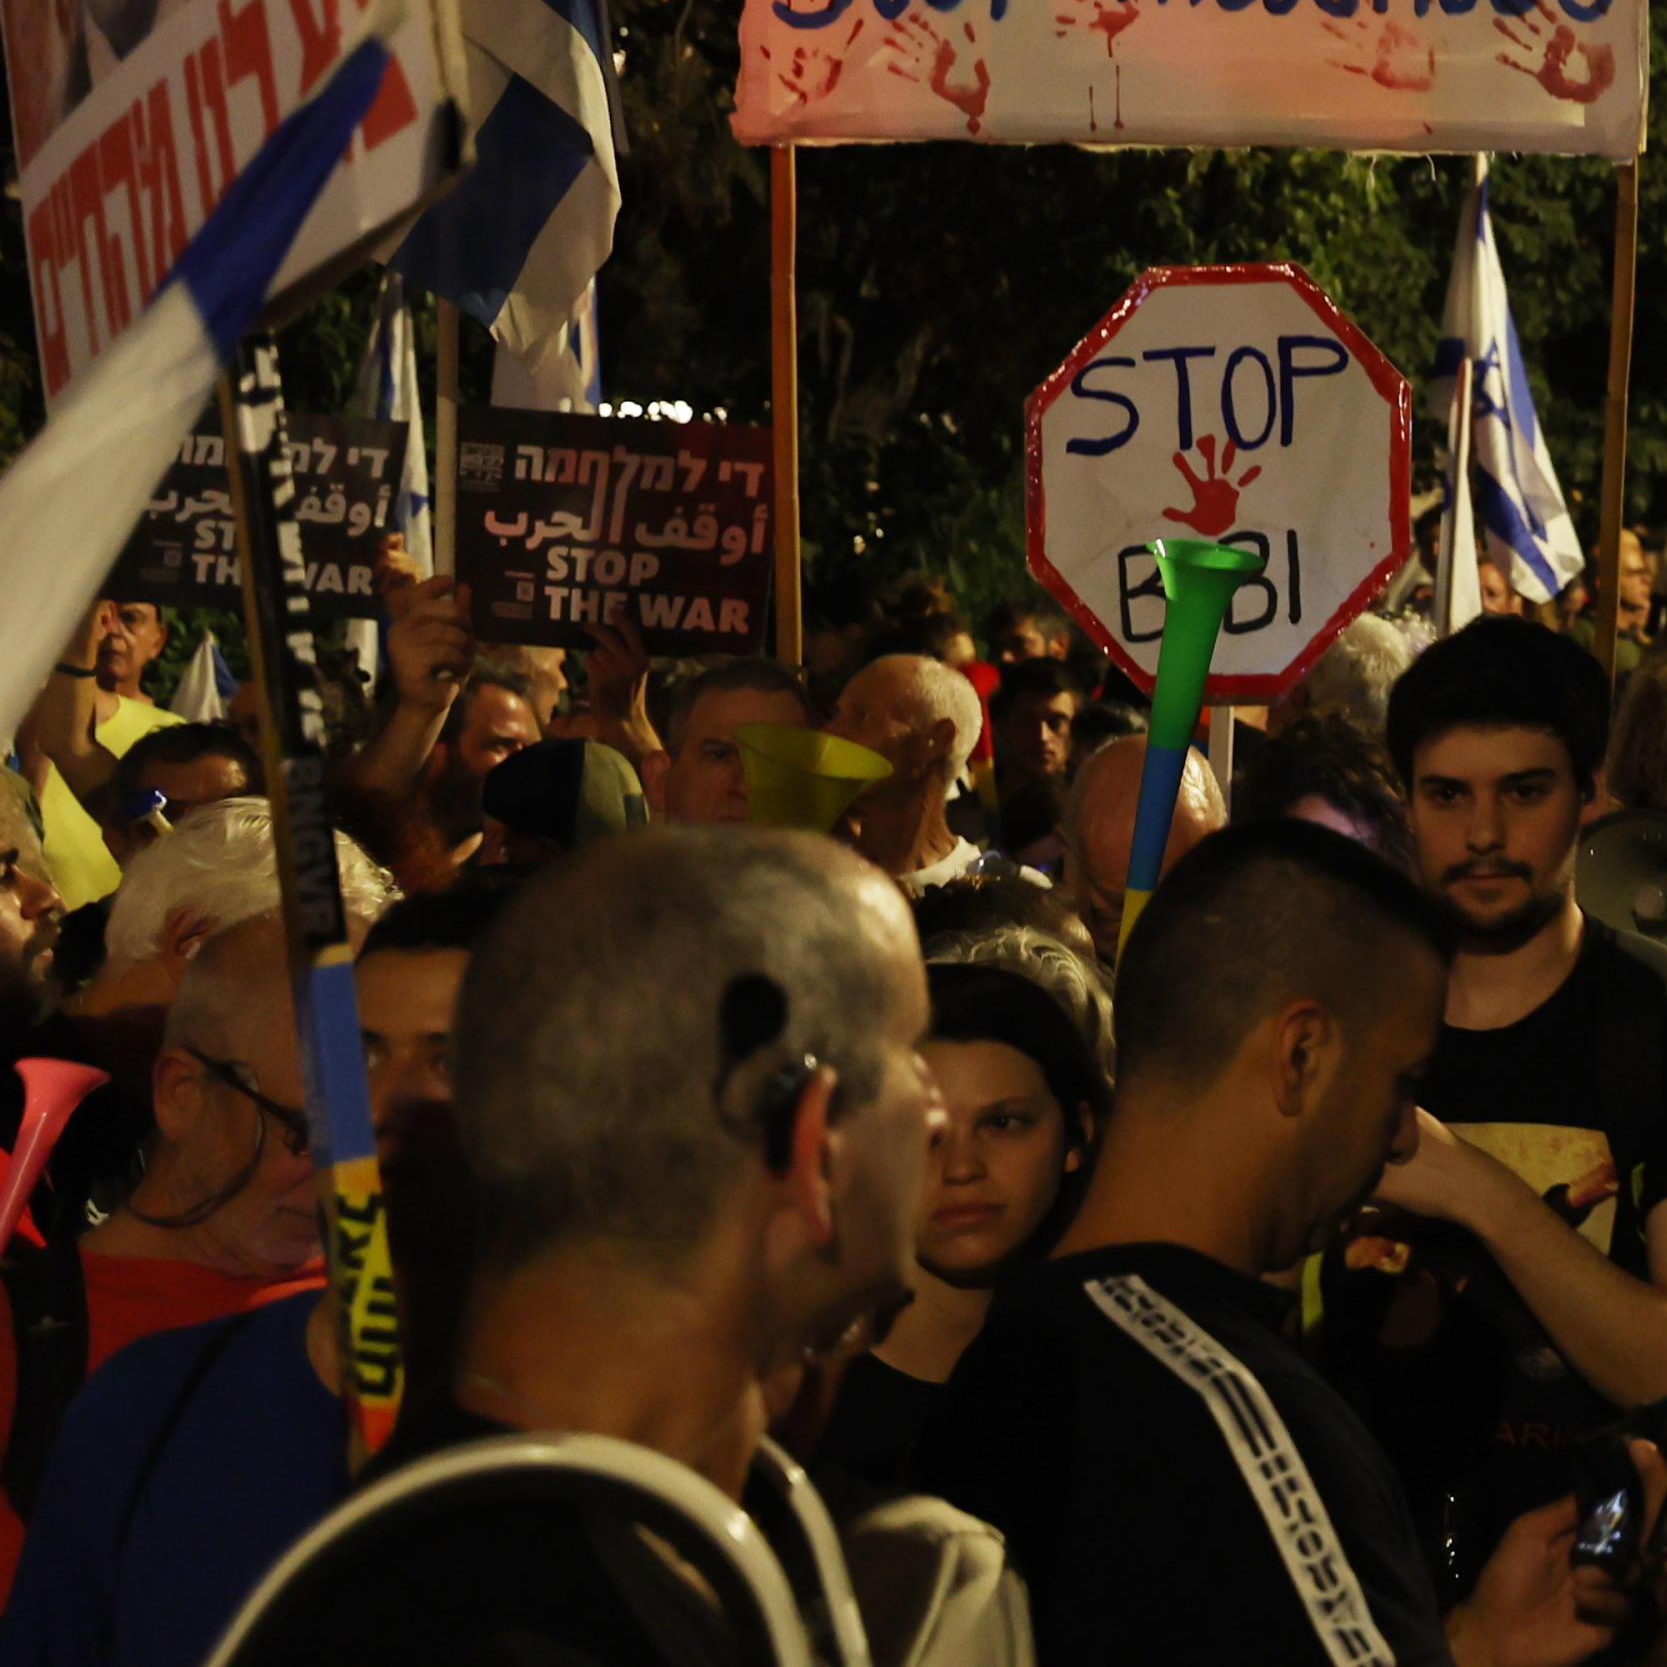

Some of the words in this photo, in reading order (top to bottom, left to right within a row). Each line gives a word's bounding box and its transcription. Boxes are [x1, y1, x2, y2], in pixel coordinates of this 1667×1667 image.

[1065, 334, 1350, 456] STOP
[717, 460, 765, 499] די
[194, 519, 236, 551] ST
[191, 553, 241, 586] TH
[546, 545, 661, 586] STOP
[1117, 529, 1303, 646] BBI
[544, 586, 631, 626] THE
[639, 593, 750, 634] WAR
